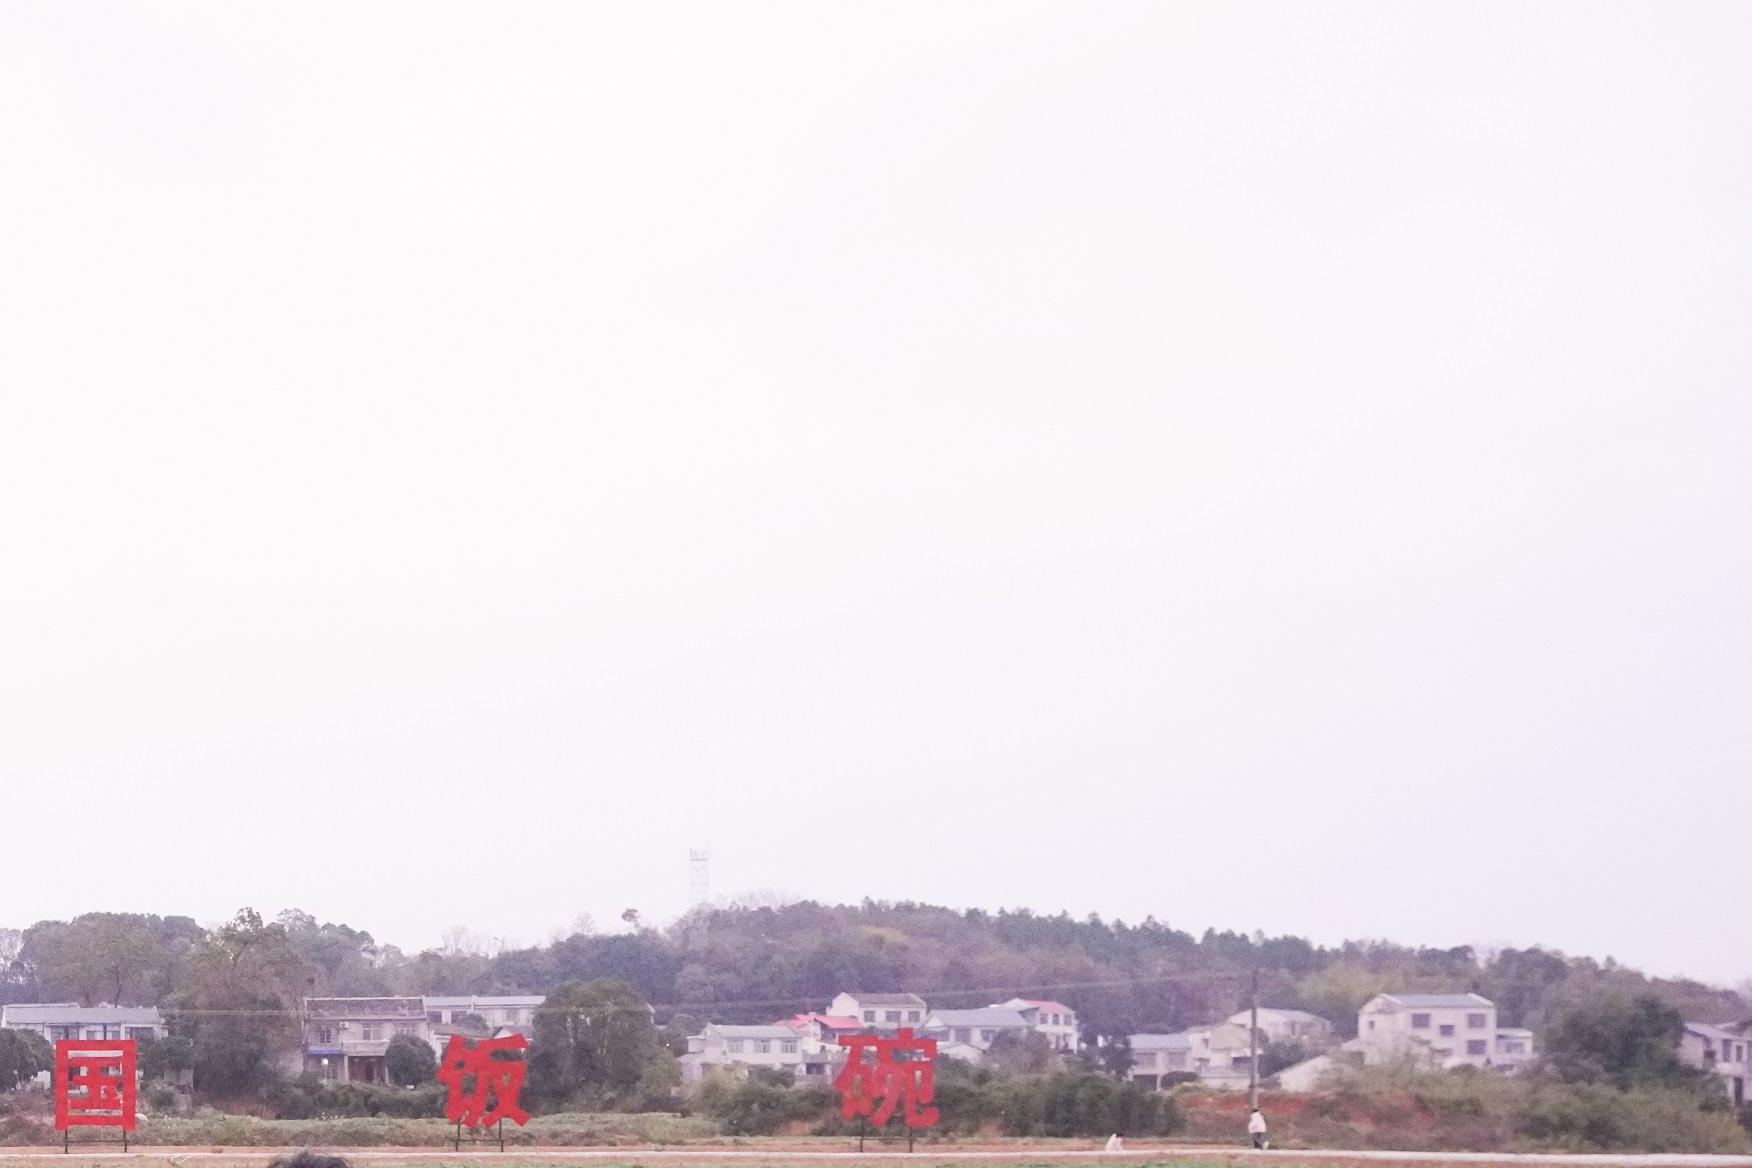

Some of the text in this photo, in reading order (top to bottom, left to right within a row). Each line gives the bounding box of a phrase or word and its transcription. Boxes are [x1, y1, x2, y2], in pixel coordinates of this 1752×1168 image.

[53, 1038, 137, 1132] 国
[435, 1033, 532, 1130] 饭
[834, 1027, 940, 1128] 碗
